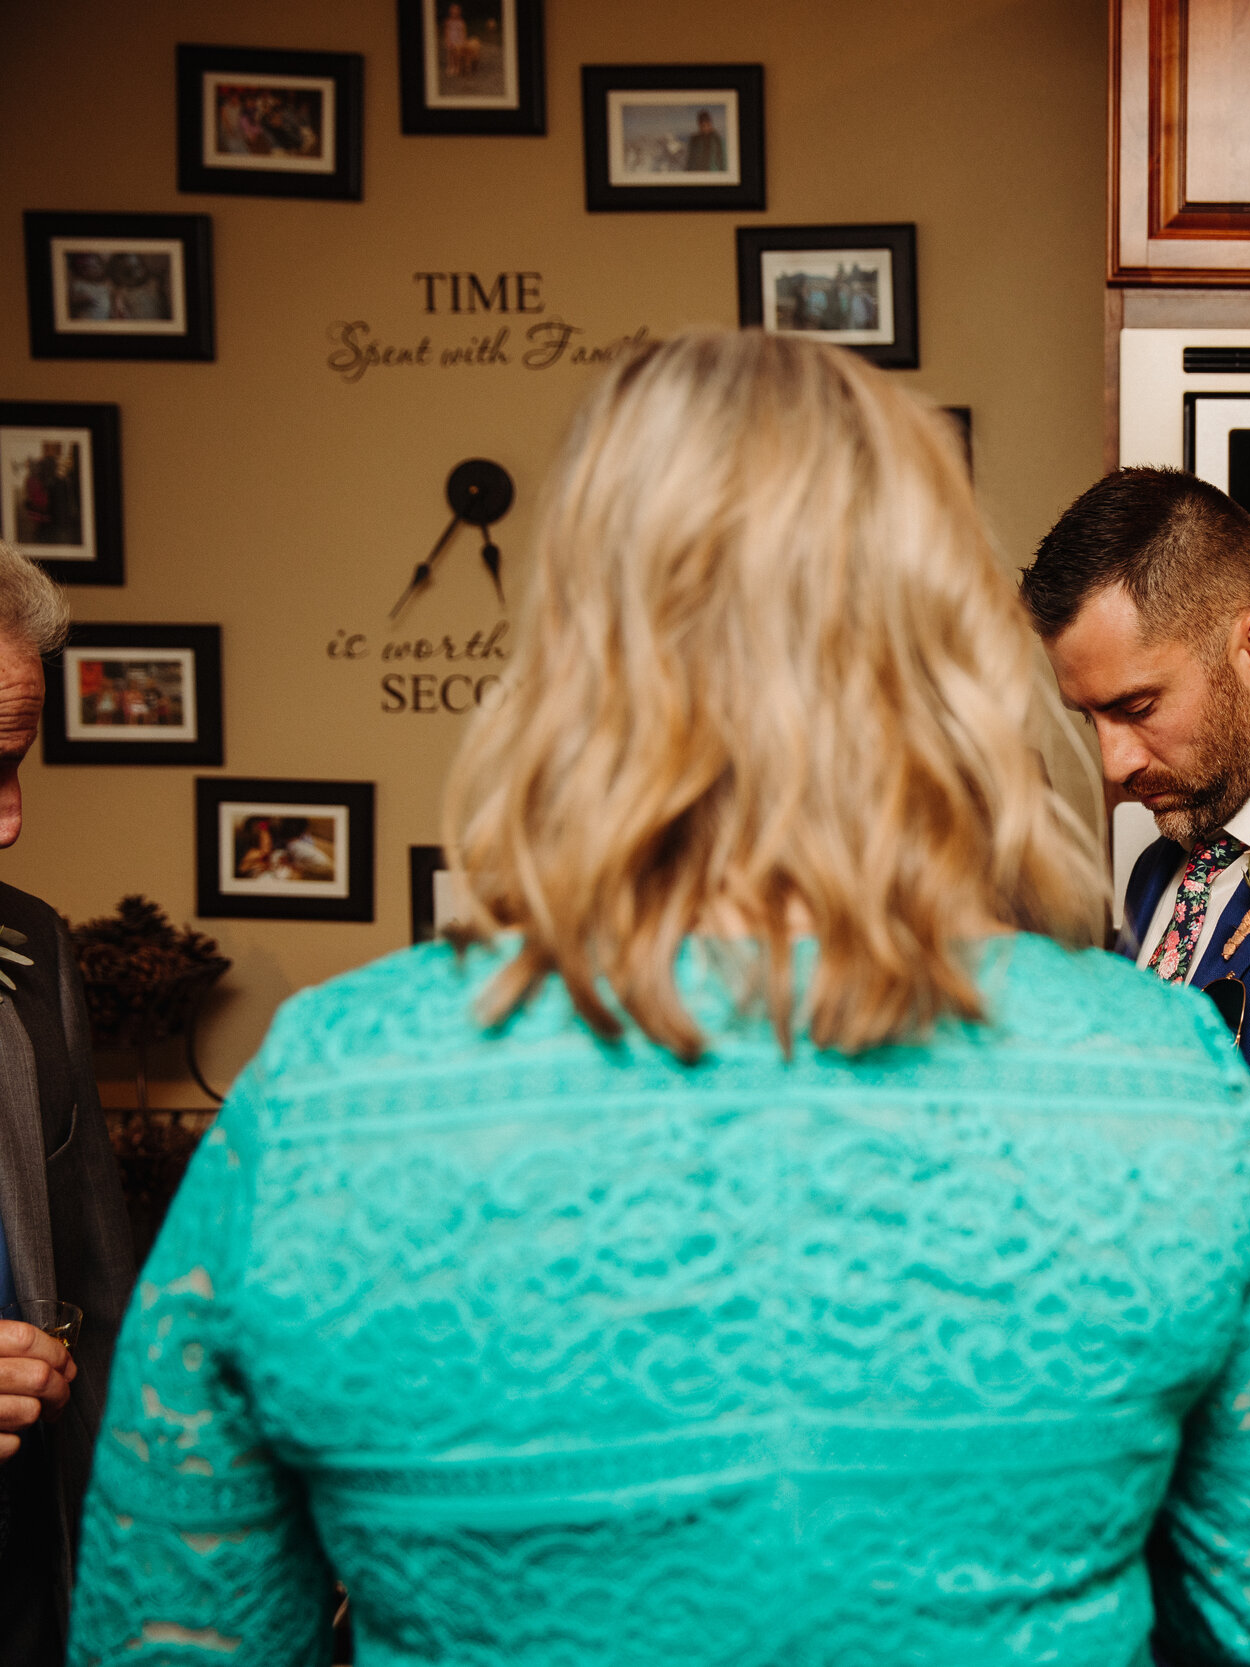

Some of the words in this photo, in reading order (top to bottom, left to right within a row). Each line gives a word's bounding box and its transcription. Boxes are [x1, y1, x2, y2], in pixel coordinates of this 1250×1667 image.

[412, 271, 545, 315] TIME
[325, 319, 431, 384] Spent
[440, 324, 512, 368] with
